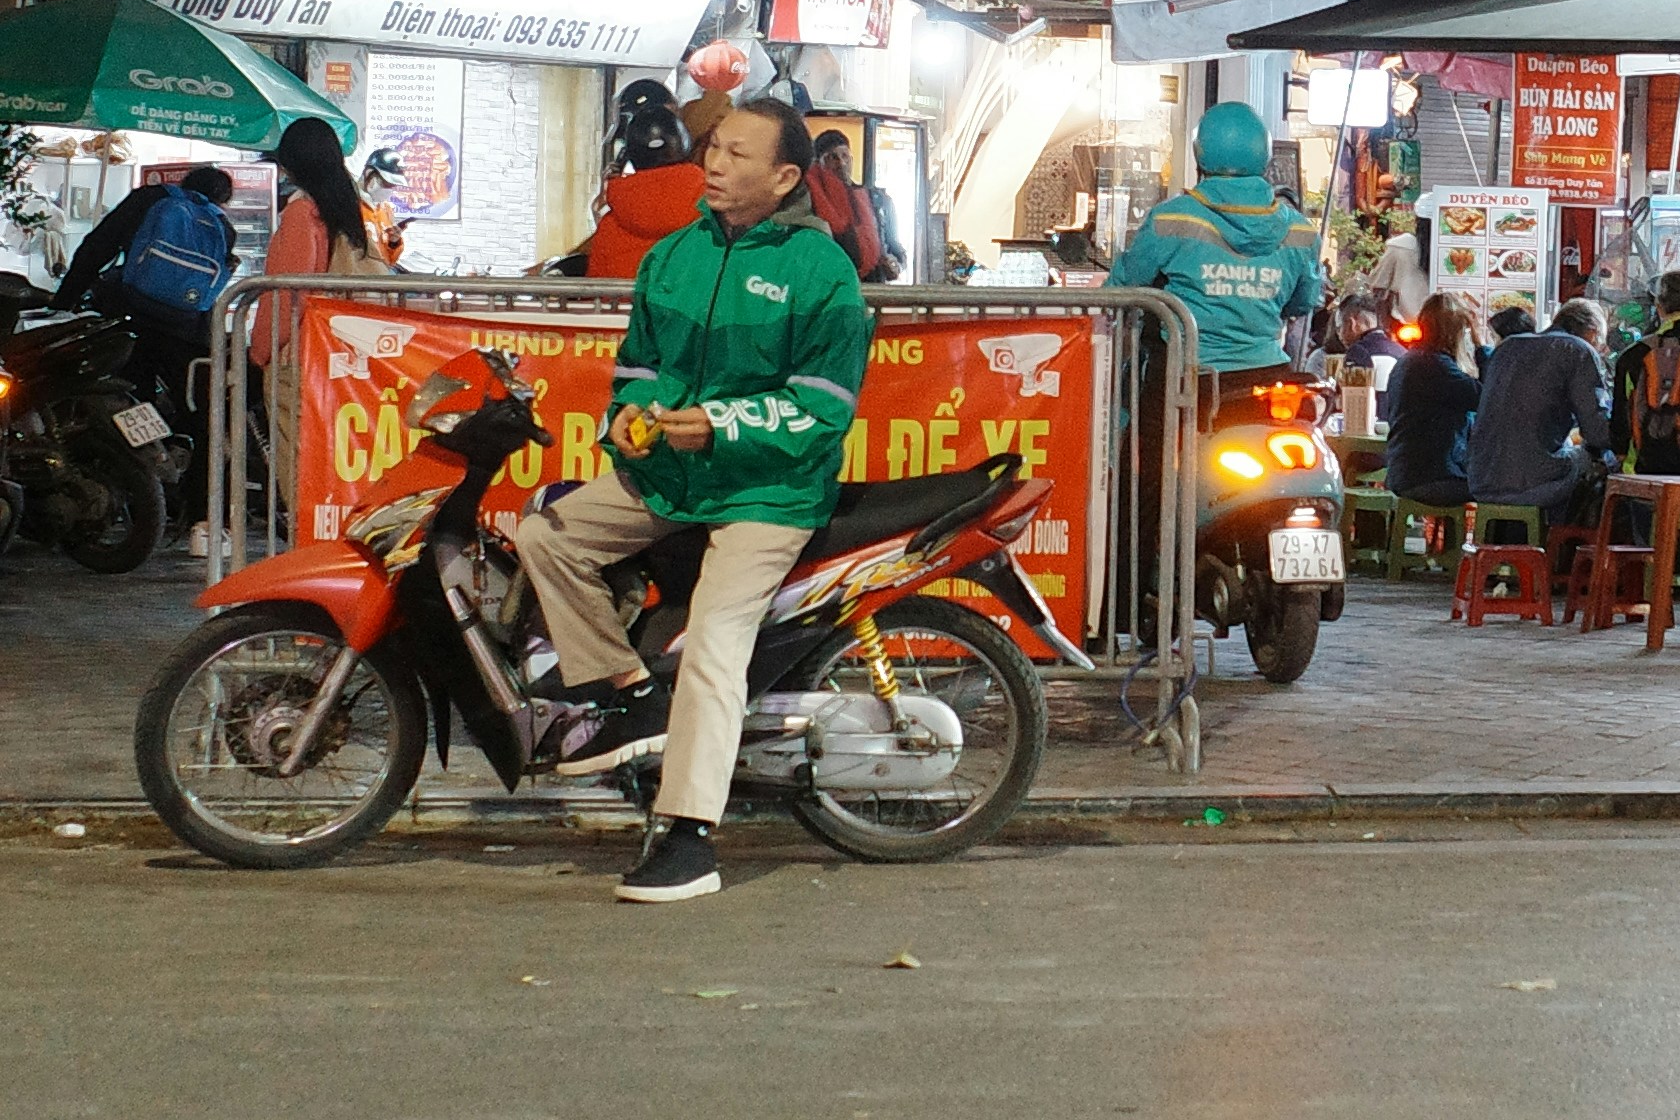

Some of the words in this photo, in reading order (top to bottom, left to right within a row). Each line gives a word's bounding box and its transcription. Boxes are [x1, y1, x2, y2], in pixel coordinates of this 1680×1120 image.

[380, 0, 437, 40] Điện
[437, 7, 502, 47] thoại:
[502, 14, 549, 45] 093
[546, 19, 591, 49] 635
[590, 24, 640, 54] 1111
[129, 69, 234, 98] Grab
[1520, 83, 1550, 107] BÚN
[1533, 116, 1553, 141] HẠ
[1557, 116, 1598, 137] LONG
[1450, 193, 1498, 205] DUYÊN
[1202, 263, 1256, 281] XANH
[1205, 280, 1233, 295] xin
[1280, 534, 1329, 554] 29-X7
[1278, 557, 1339, 578] 732.64
